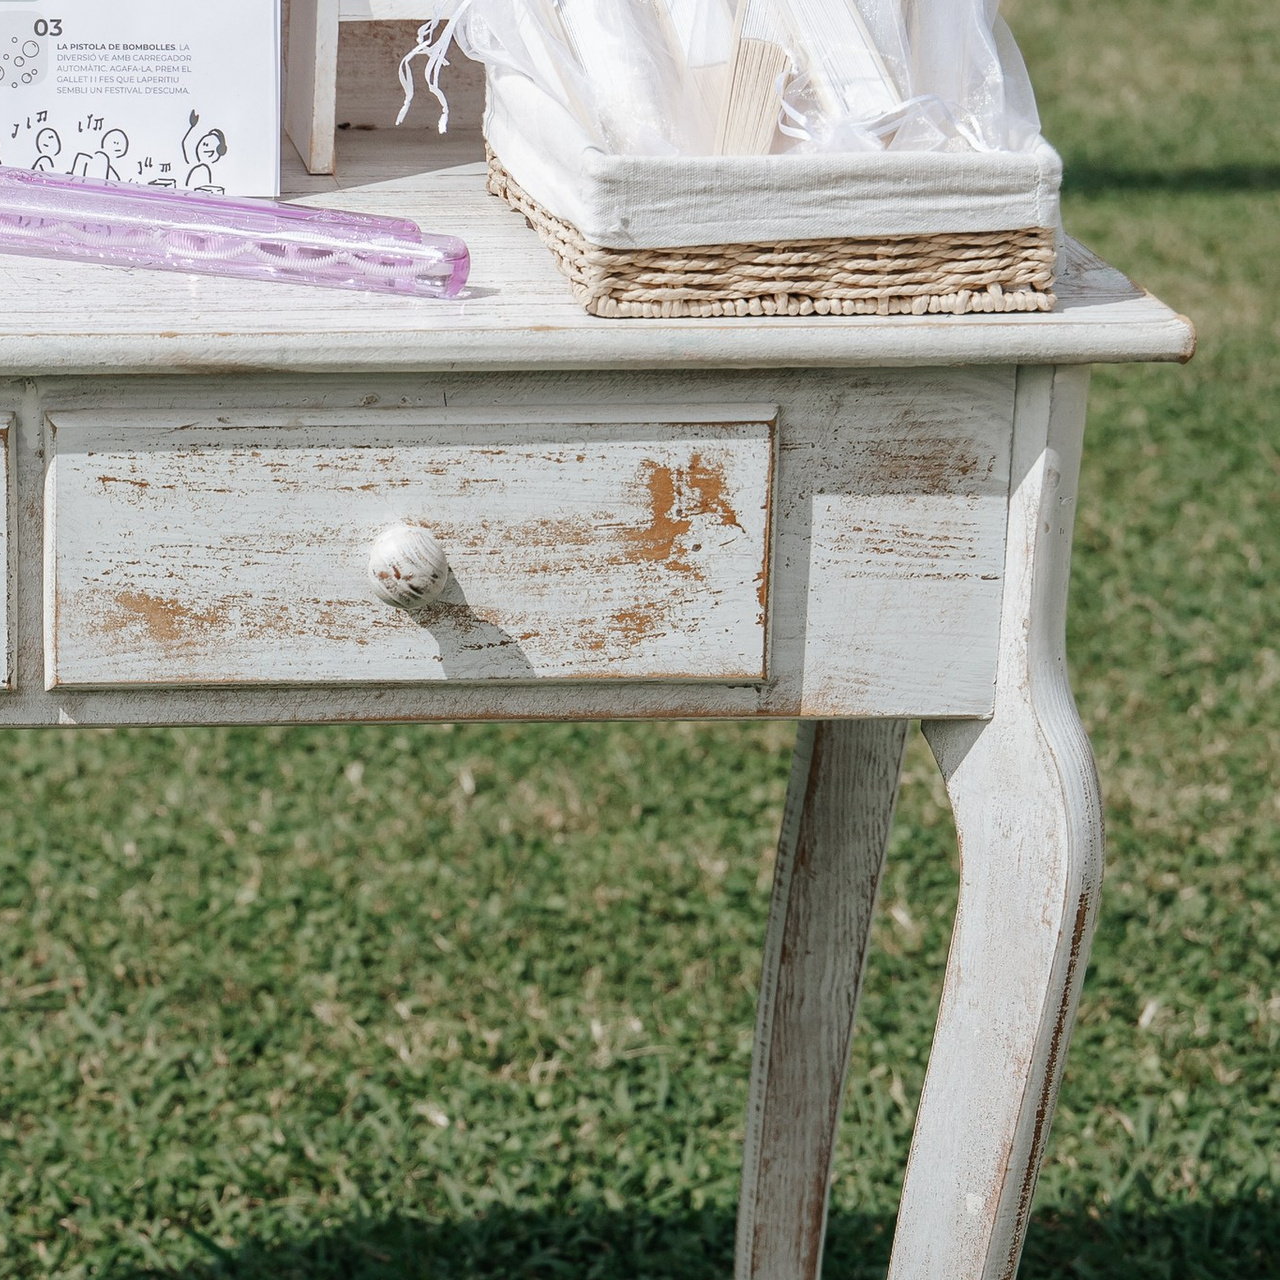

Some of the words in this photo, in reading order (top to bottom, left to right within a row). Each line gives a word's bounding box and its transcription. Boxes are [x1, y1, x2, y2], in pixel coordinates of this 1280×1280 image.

[34, 19, 62, 36] 03
[57, 53, 96, 61] DIVERSIÓ
[116, 76, 134, 84] QUE
